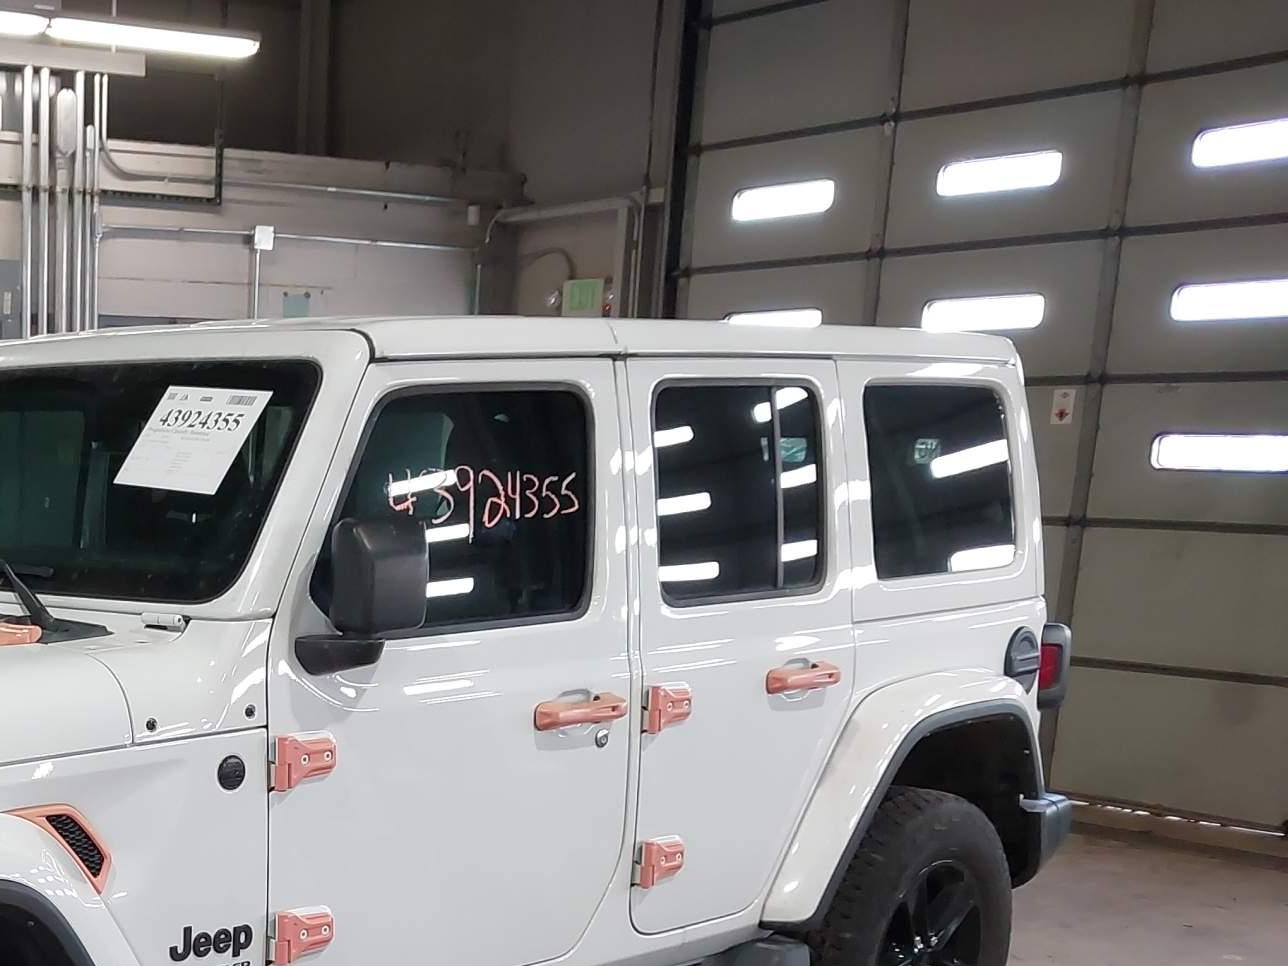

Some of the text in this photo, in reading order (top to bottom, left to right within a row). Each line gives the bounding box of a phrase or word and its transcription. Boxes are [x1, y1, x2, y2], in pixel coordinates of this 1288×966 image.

[159, 408, 245, 432] 43924355
[386, 465, 580, 544] 43924355
[169, 924, 253, 962] Jeep
